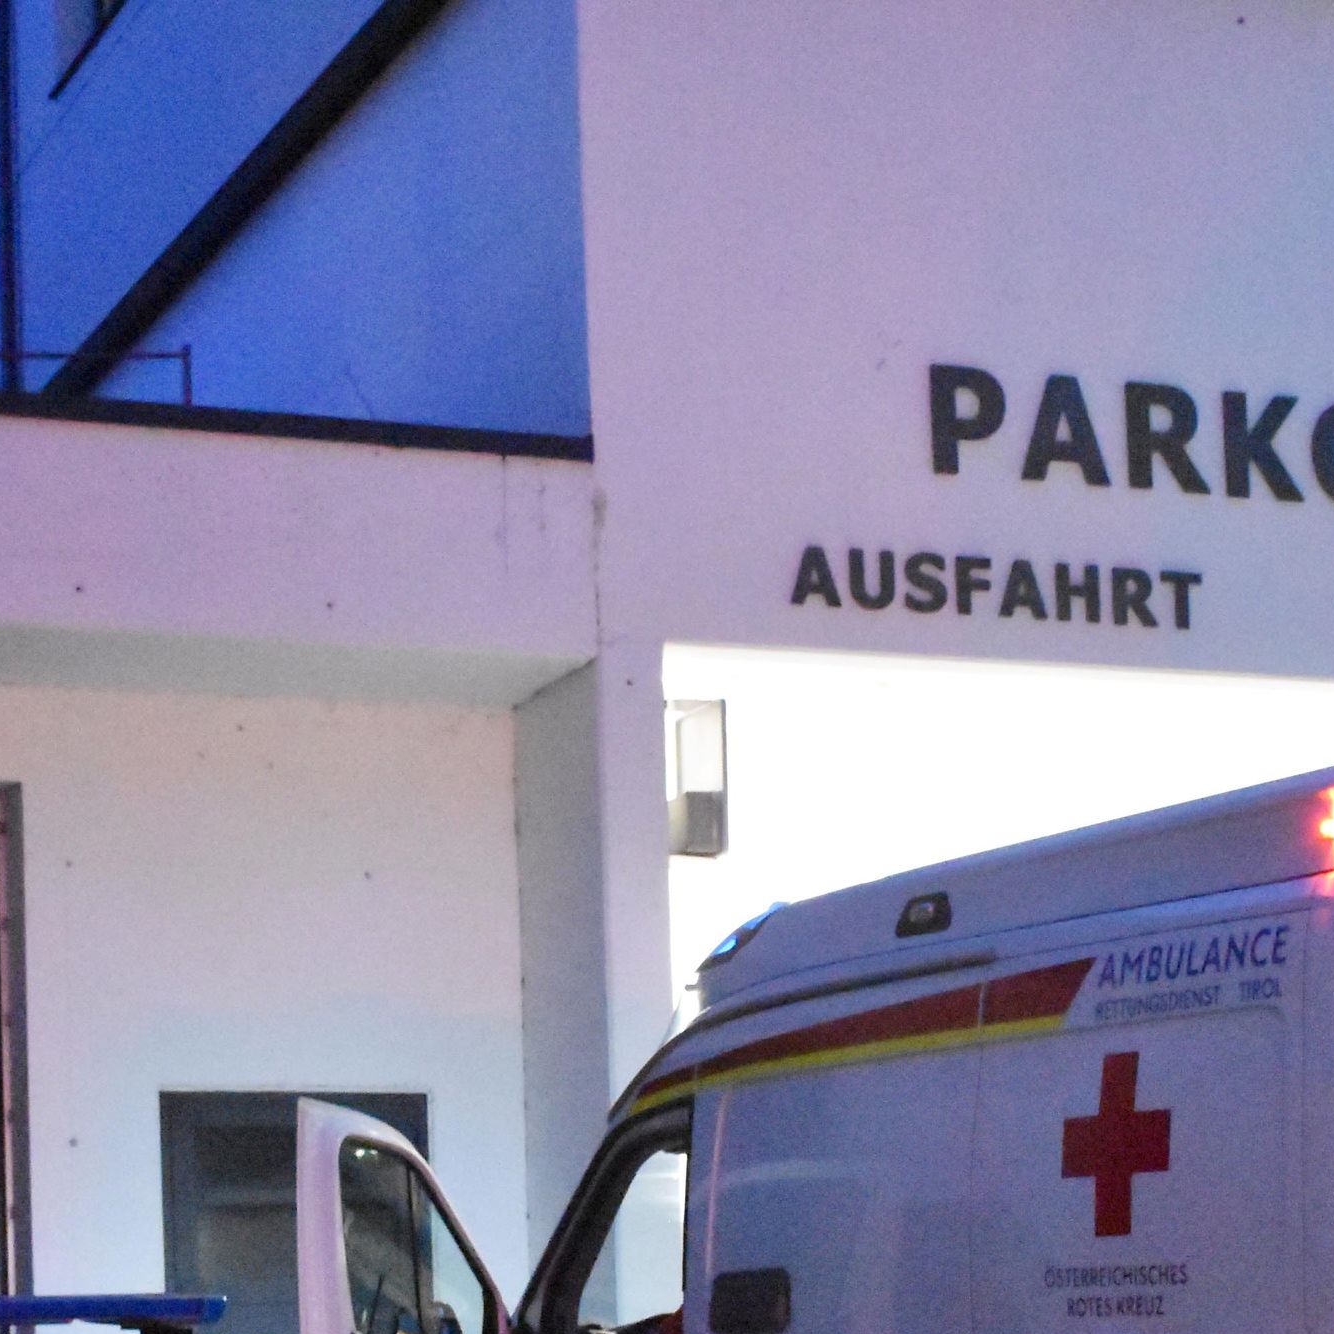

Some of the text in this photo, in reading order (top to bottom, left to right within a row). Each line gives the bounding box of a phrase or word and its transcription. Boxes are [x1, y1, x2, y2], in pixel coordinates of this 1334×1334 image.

[789, 545, 1203, 631] AUSFAHRT
[1098, 925, 1291, 988] AMBULANCE
[1067, 1295, 1165, 1317] ROTES KREUZ
